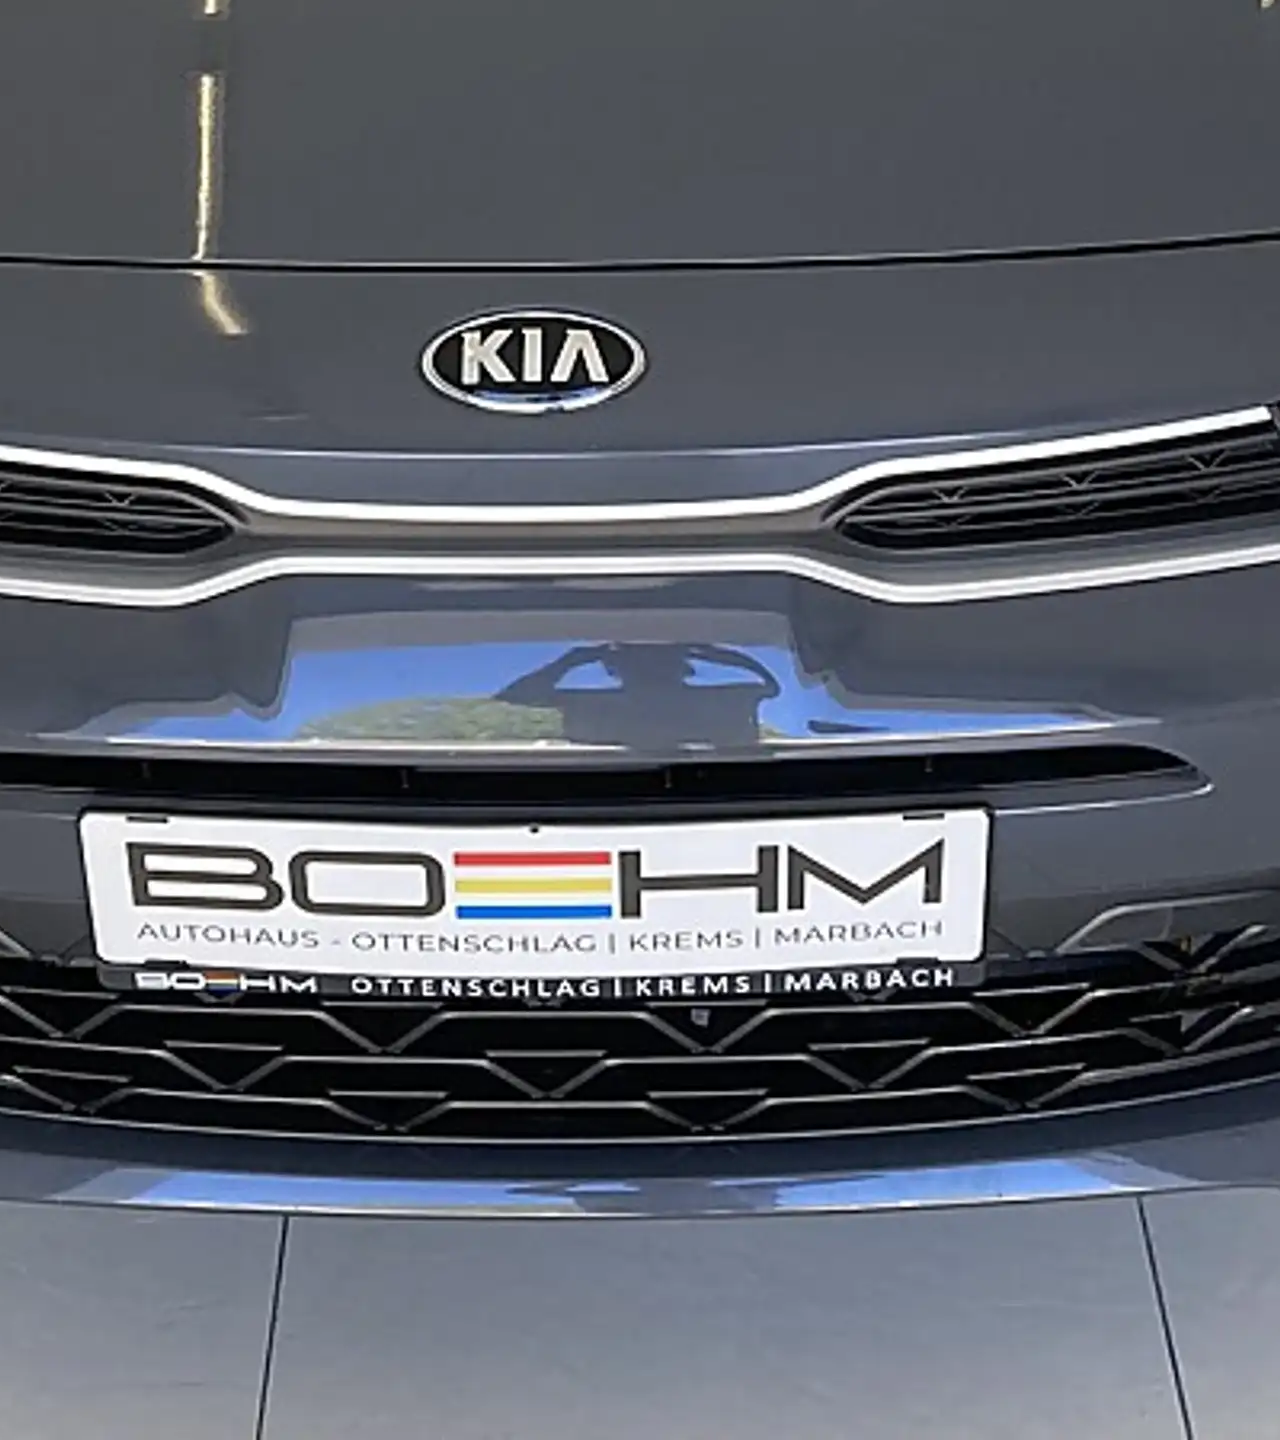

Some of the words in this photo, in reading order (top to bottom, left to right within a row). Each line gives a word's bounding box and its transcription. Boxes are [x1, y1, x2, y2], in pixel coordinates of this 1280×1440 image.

[461, 327, 610, 386] KIA
[136, 921, 320, 949] AUTOHAUS
[351, 931, 597, 954] OTTENSCHLAG
[629, 928, 744, 952] KREMS
[774, 920, 943, 946] MARBACH
[351, 975, 601, 998] OTTENSCHLAG
[636, 975, 751, 997] KREMS
[784, 968, 954, 991] MARBACH
